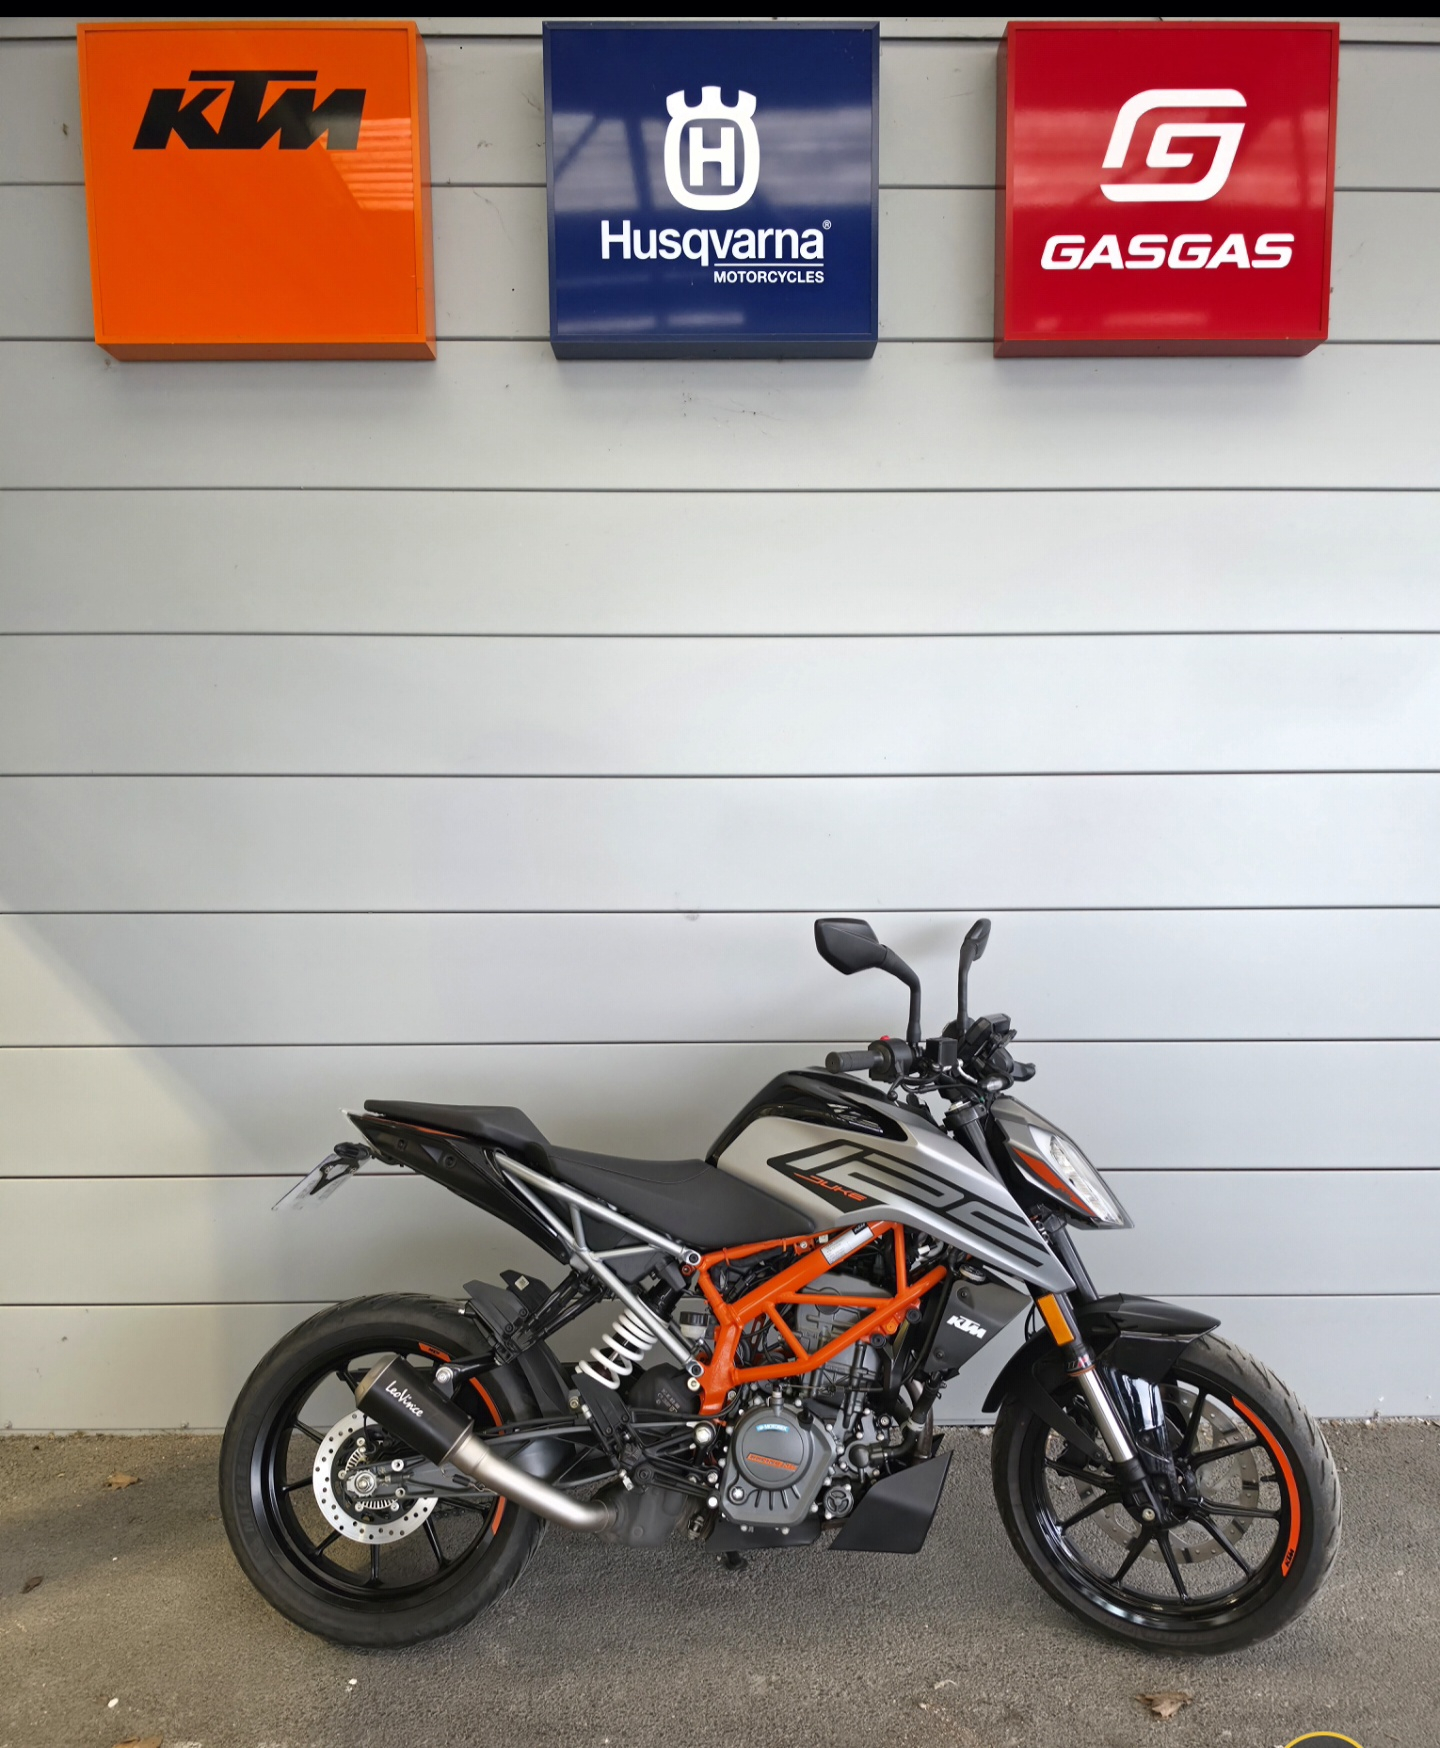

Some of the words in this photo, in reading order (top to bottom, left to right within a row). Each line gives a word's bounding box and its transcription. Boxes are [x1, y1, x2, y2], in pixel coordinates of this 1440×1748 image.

[133, 70, 366, 150] KTM
[1040, 233, 1295, 270] GASGAS
[713, 270, 825, 284] MOTORCYCLES
[793, 1172, 868, 1202] DUKE
[946, 1315, 987, 1339] KTM
[385, 1380, 424, 1417] LeoVince
